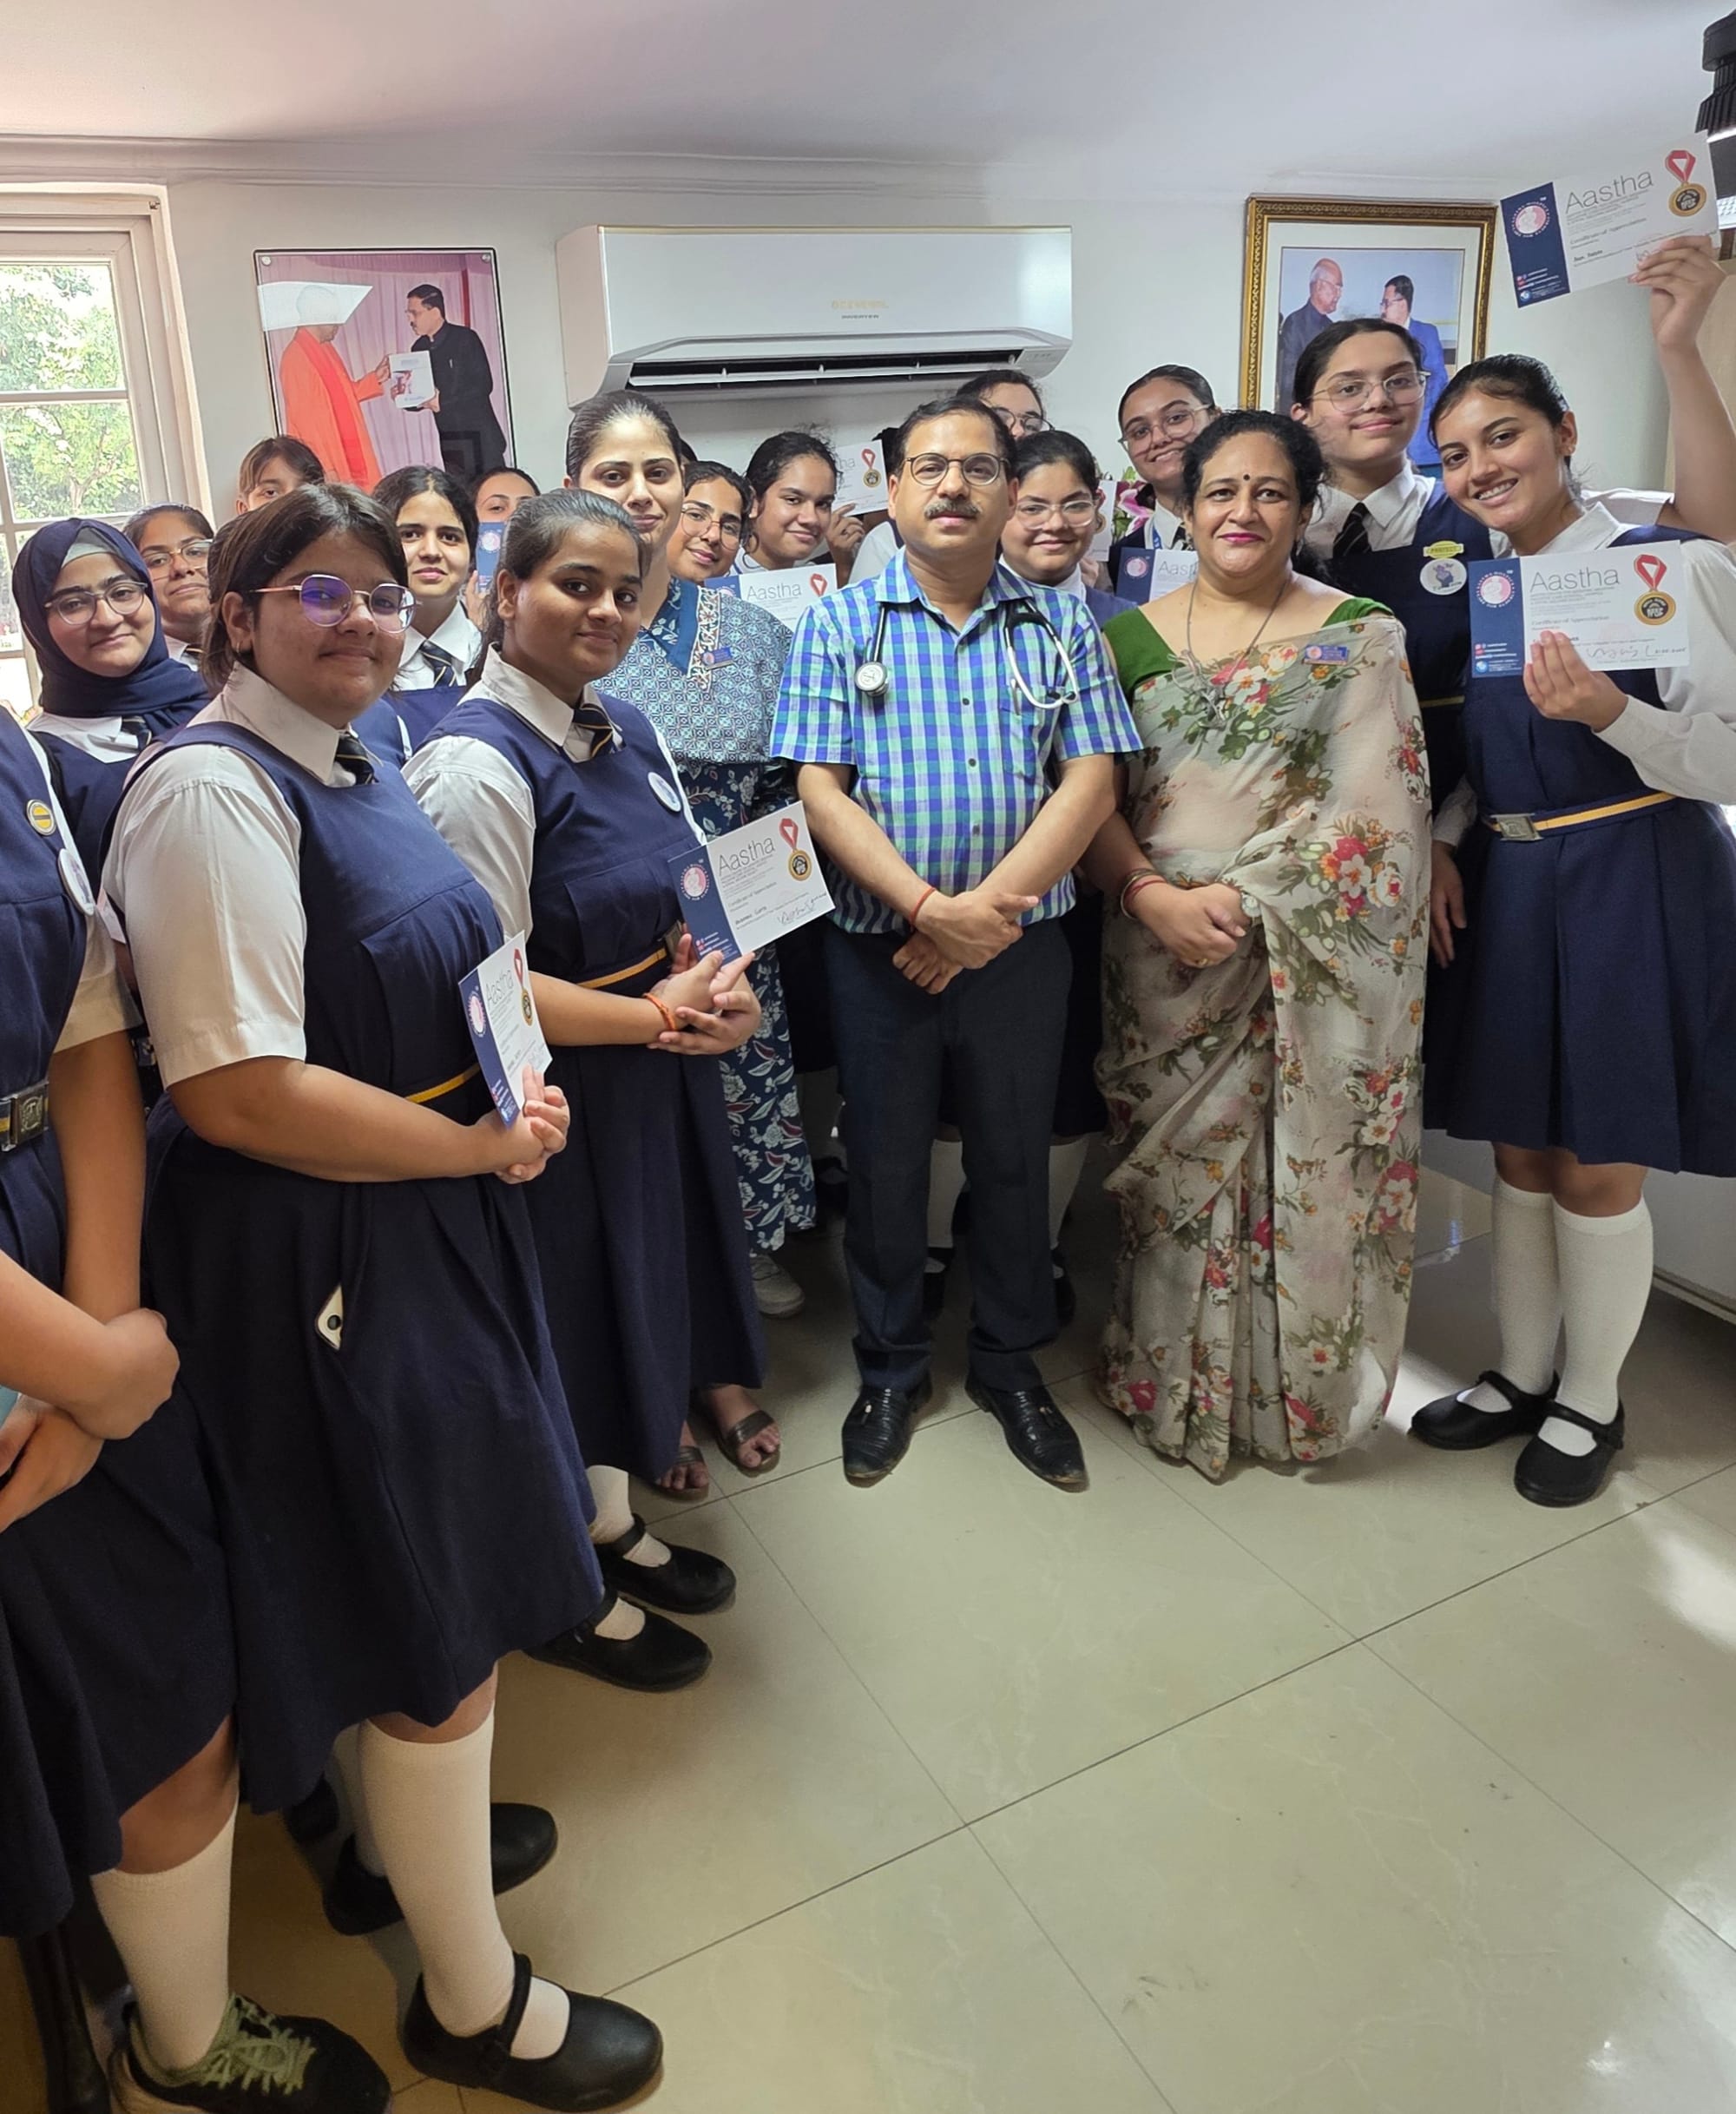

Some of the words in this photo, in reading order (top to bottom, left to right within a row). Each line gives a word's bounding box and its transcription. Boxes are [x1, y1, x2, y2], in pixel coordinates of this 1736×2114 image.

[1565, 171, 1654, 214] Aastha
[746, 583, 802, 601] Aastha
[1529, 566, 1621, 592] Aastha
[719, 837, 776, 877] Aastha
[485, 969, 514, 1009] Aastha
